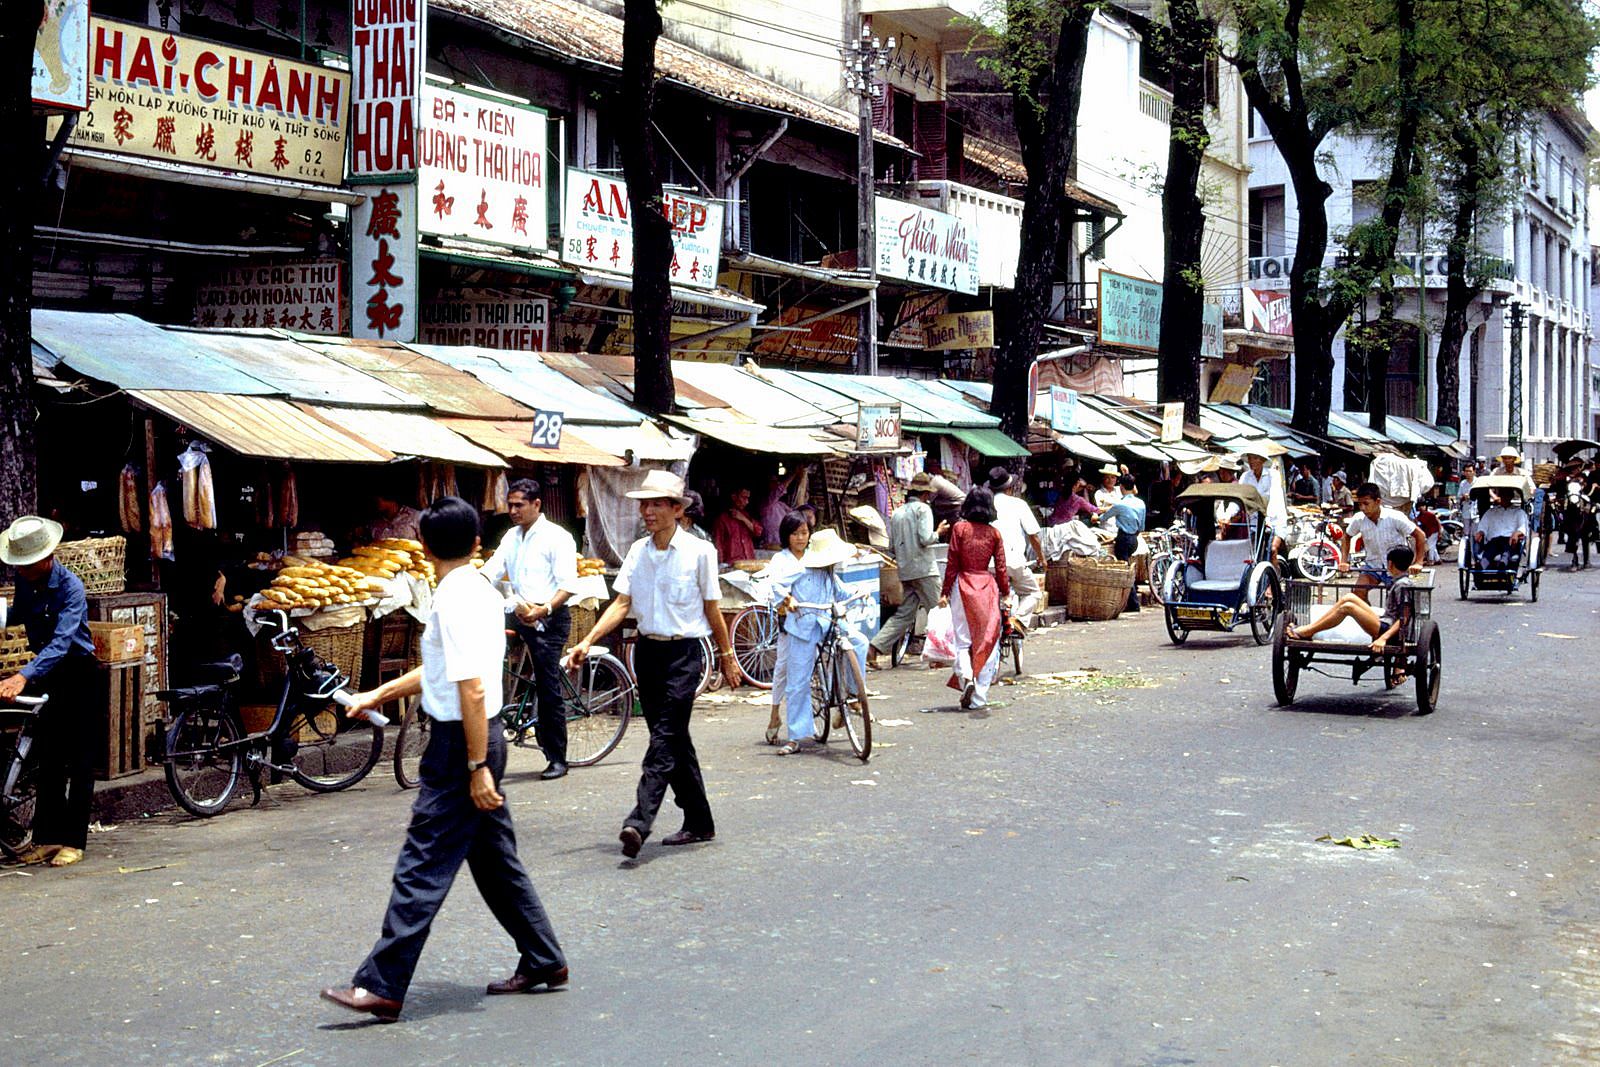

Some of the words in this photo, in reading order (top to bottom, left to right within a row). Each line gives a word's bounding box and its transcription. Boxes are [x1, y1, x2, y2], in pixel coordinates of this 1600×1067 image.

[352, 100, 415, 172] HOA
[568, 238, 582, 254] 58
[702, 264, 713, 279] 58
[532, 413, 562, 446] 28
